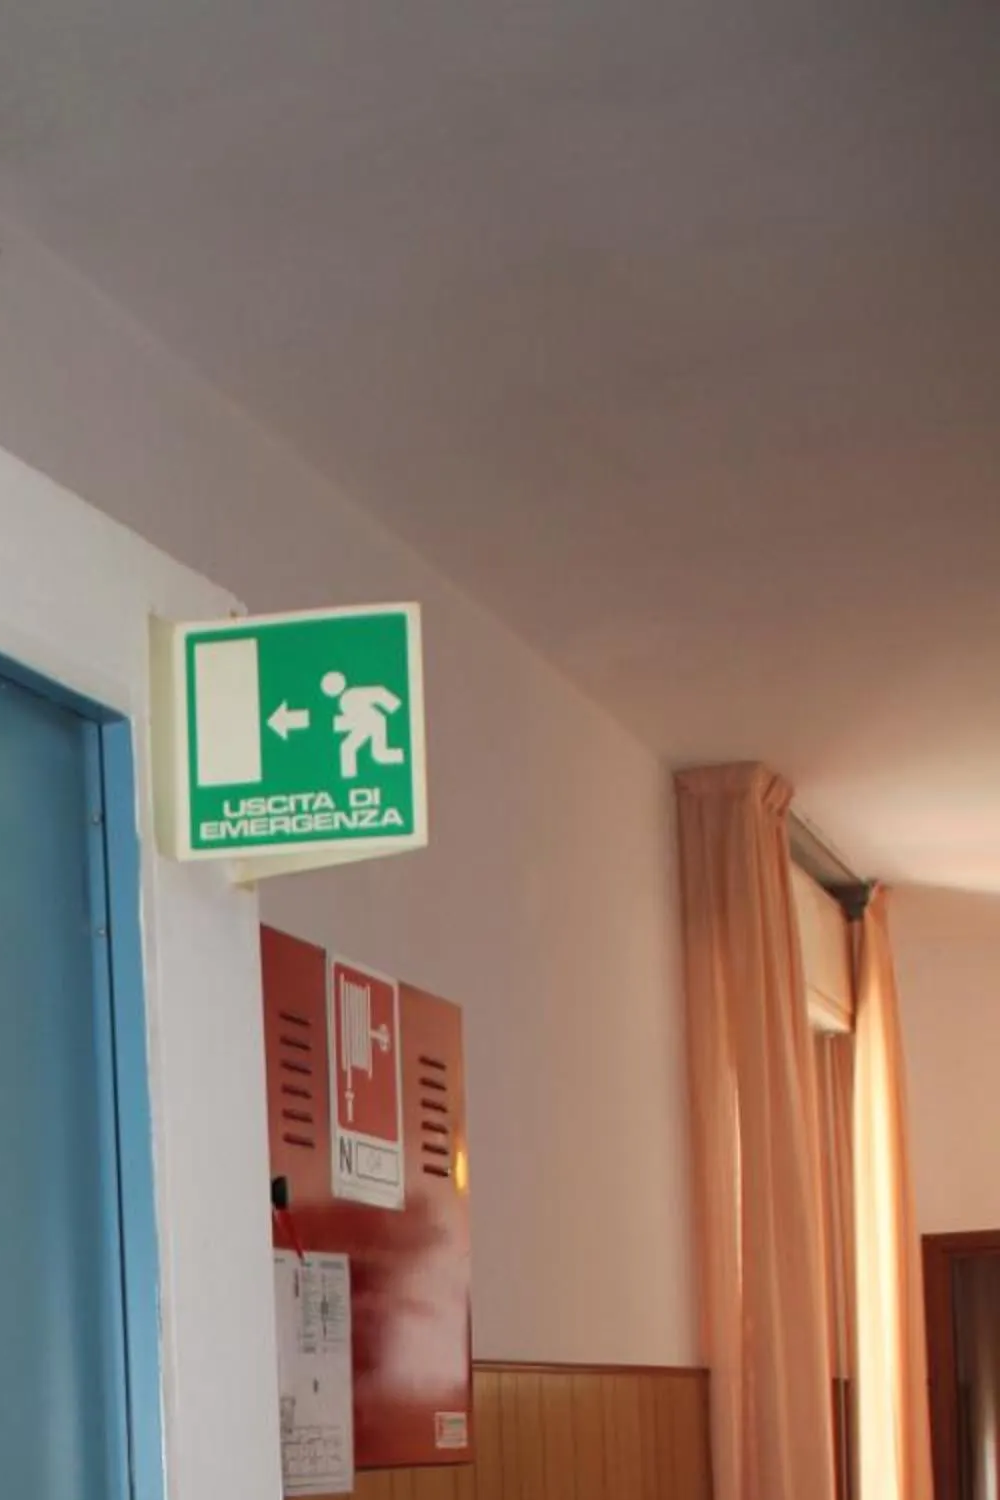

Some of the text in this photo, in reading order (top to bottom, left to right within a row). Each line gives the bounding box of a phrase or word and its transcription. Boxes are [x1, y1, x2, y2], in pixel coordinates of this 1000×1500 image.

[223, 787, 381, 818] USCITA DI
[199, 807, 404, 841] EMERGENZA
